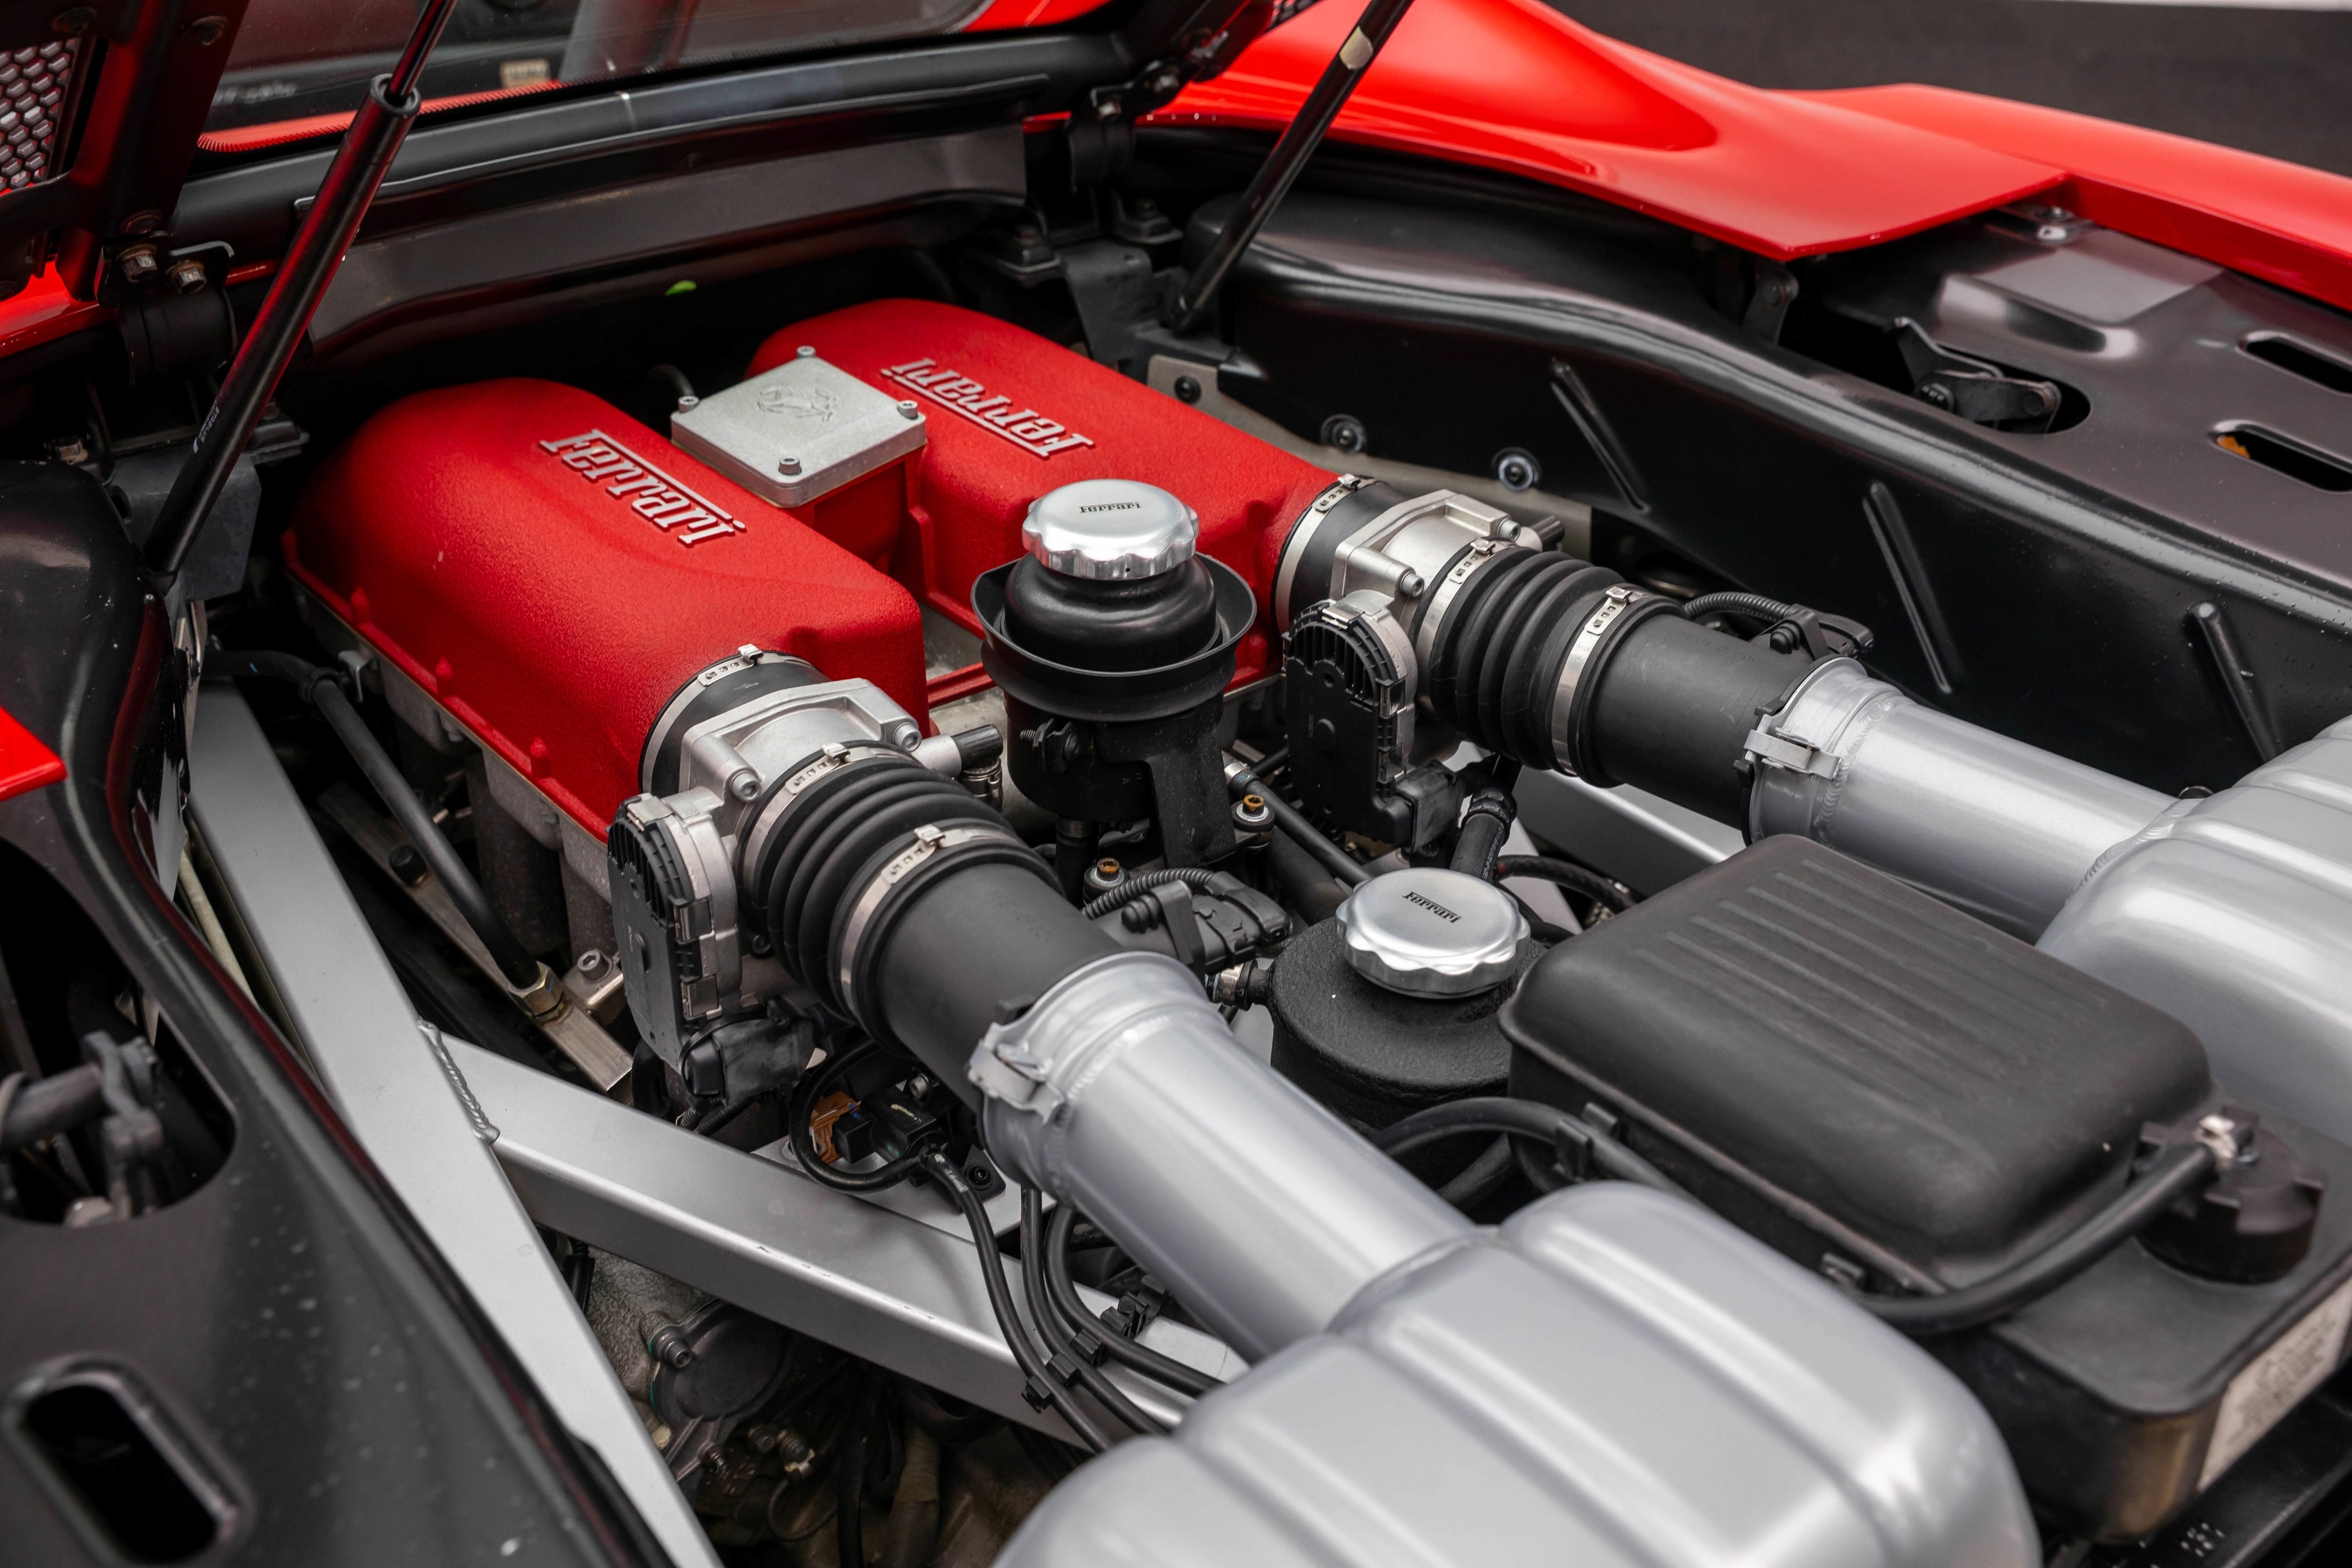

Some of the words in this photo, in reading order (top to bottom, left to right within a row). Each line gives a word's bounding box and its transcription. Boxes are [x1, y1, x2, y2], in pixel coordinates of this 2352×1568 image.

[881, 358, 1095, 460] Ferrari
[539, 429, 746, 548] Ferrari
[1078, 501, 1141, 513] Ferrari
[1402, 891, 1462, 923] Ferrari
